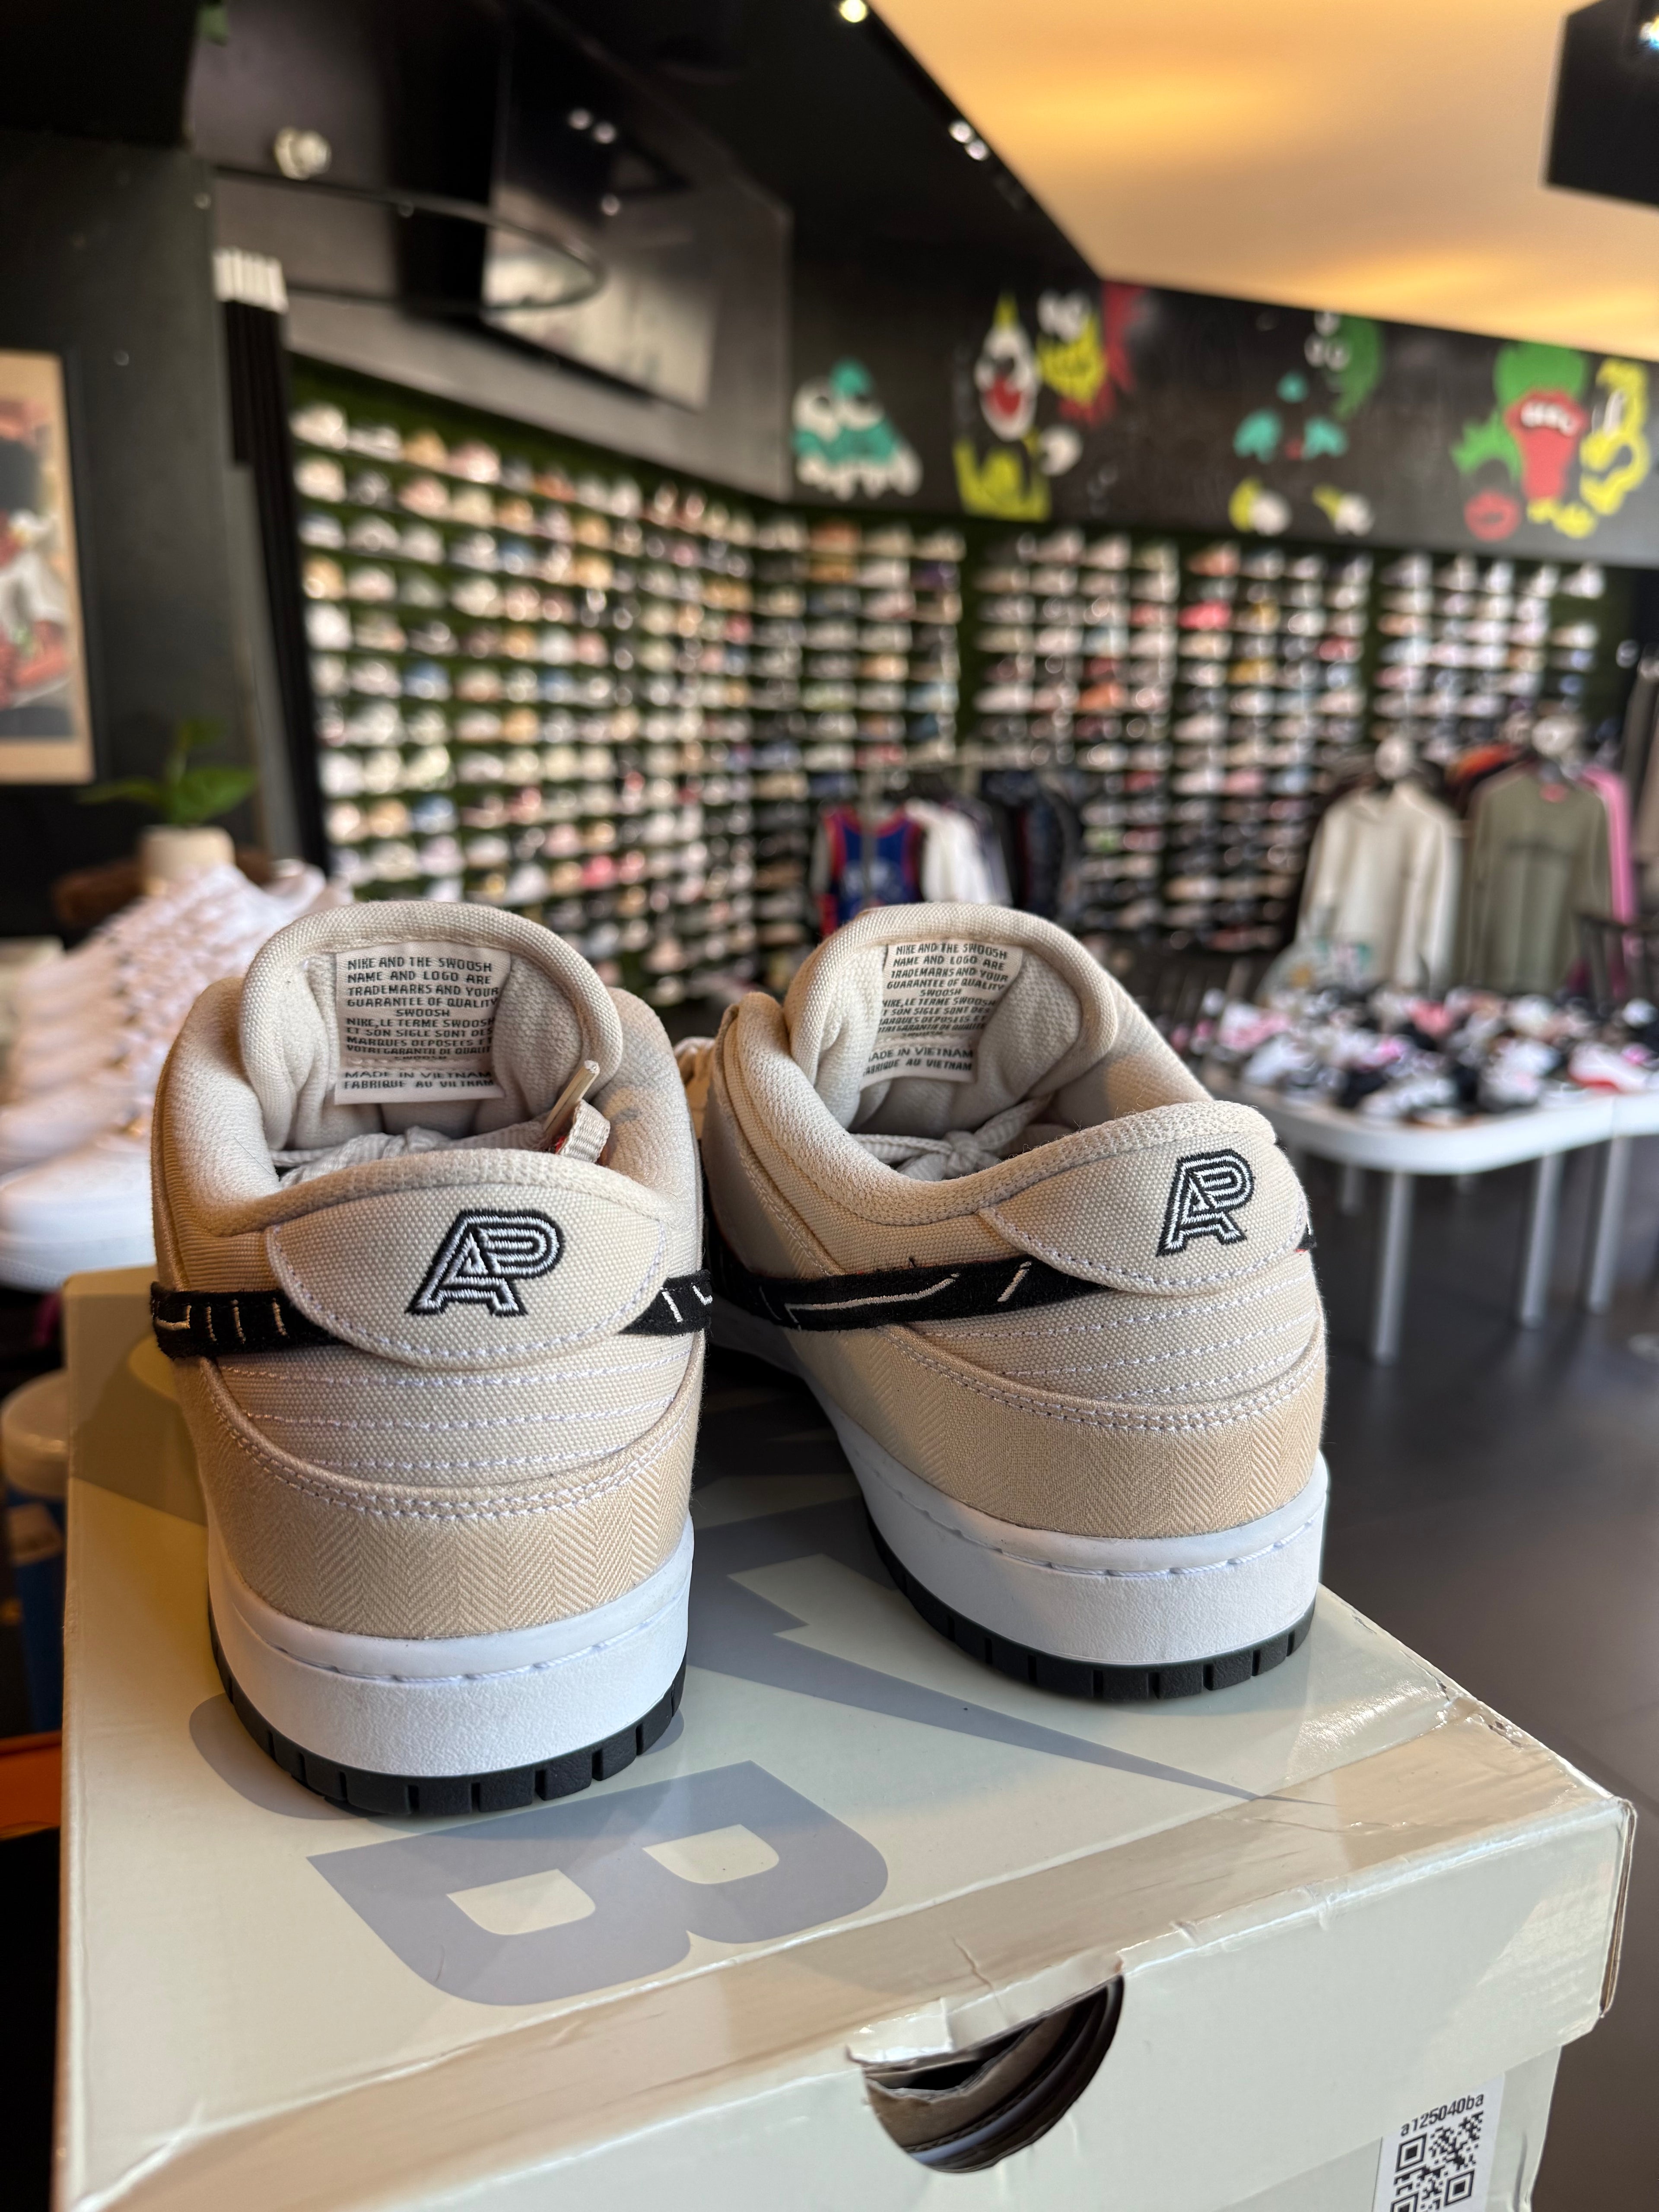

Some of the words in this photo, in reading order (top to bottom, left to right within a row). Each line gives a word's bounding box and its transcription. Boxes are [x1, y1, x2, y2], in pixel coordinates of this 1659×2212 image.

[896, 944, 916, 955] NIKE
[918, 943, 938, 953] AND
[941, 943, 959, 953] THE
[963, 943, 1007, 960] SWOOSH
[348, 958, 376, 970] NIKE
[378, 957, 404, 968] AND
[410, 957, 432, 967] THE
[439, 958, 492, 972] SWOOSH
[893, 957, 919, 967] NAME
[923, 955, 945, 964] AND
[950, 956, 978, 965] LOGO
[982, 959, 1004, 971] ARE
[348, 972, 383, 983] NAME
[391, 971, 416, 981] AND
[424, 971, 458, 982] LOGO
[467, 974, 491, 985] ARE
[891, 967, 954, 979] TRADEMARKS
[956, 967, 977, 976] AND
[980, 970, 1008, 982] YOUR
[348, 984, 432, 996] TRADEMARKS
[436, 985, 461, 995] AND
[466, 987, 499, 997] YOUR
[887, 979, 944, 989] GUARANTEE
[947, 979, 959, 987] OF
[961, 979, 1005, 991] QUALITY
[919, 988, 962, 997] SWOOSH
[347, 997, 425, 1007] GUARANTEE
[428, 997, 443, 1006] OF
[447, 997, 498, 1008] QUALITY
[952, 997, 996, 1006] SWOOSH
[396, 1009, 450, 1017] SWOOSH
[944, 1006, 969, 1014] SONT
[398, 1019, 439, 1027] TERME
[443, 1017, 495, 1028] SWOOSH
[879, 1017, 920, 1025] ARQUES
[346, 1036, 407, 1046] MARQUES
[868, 1049, 893, 1062] ADE
[898, 1048, 910, 1056] IN
[915, 1047, 973, 1058] VIETNAM
[864, 1059, 900, 1076] ABRIQUE
[926, 1059, 972, 1071] VIETNAM
[344, 1081, 405, 1089] FABRIQUE
[1400, 2093, 1484, 2137] a125040ba
